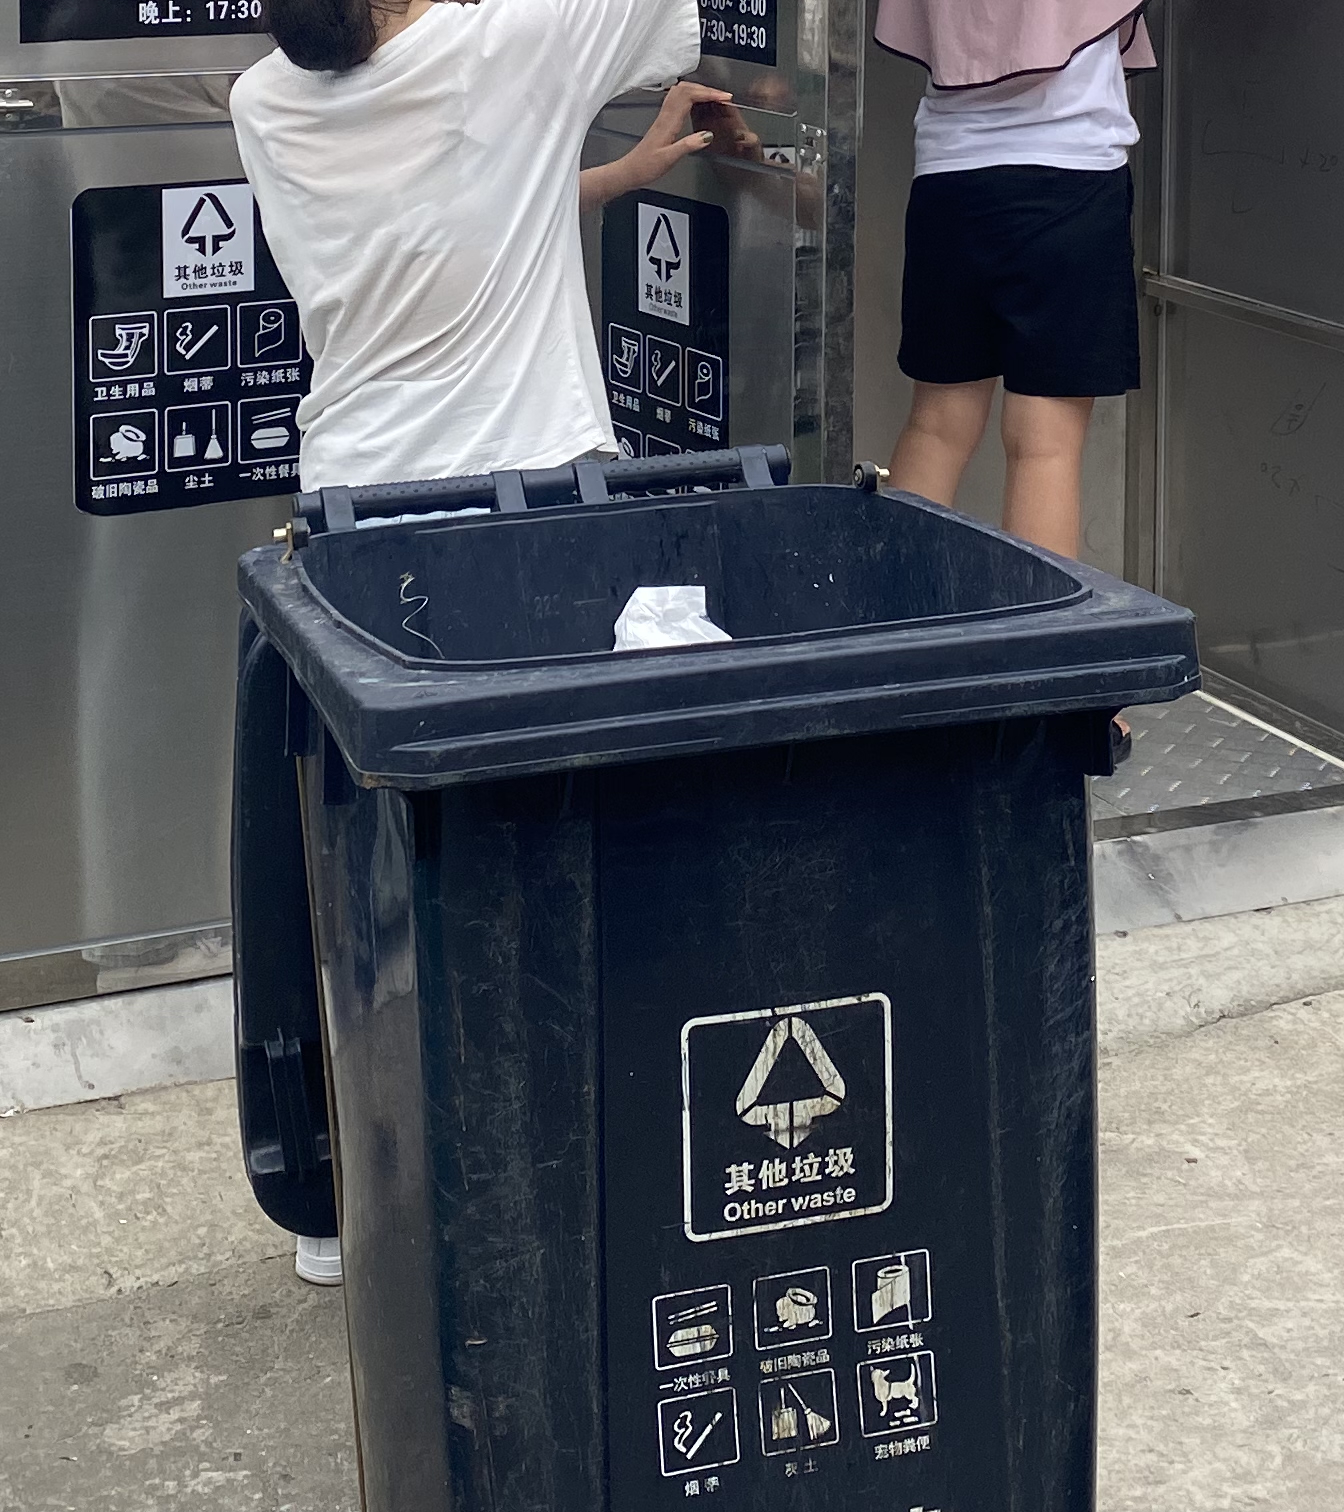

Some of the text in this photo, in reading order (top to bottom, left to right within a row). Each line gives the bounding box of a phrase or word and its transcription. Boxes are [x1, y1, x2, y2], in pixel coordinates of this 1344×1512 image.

[206, 0, 262, 19] 17:30
[174, 261, 244, 281] 其他垃圾
[181, 280, 237, 290] Other waste
[644, 283, 683, 309] 其他垃圾
[183, 376, 214, 392] 烟蒂
[240, 368, 301, 386] 污染纸张
[93, 381, 156, 401] 卫生用品
[185, 473, 214, 489] 尘土
[239, 464, 301, 481] 一次性餐具
[91, 478, 159, 500] 破旧陶瓷品
[724, 1147, 855, 1196] 其他垃圾
[723, 1186, 856, 1222] Other waste
[867, 1333, 924, 1355] 污染纸张
[874, 1434, 931, 1460] 宠物粪便
